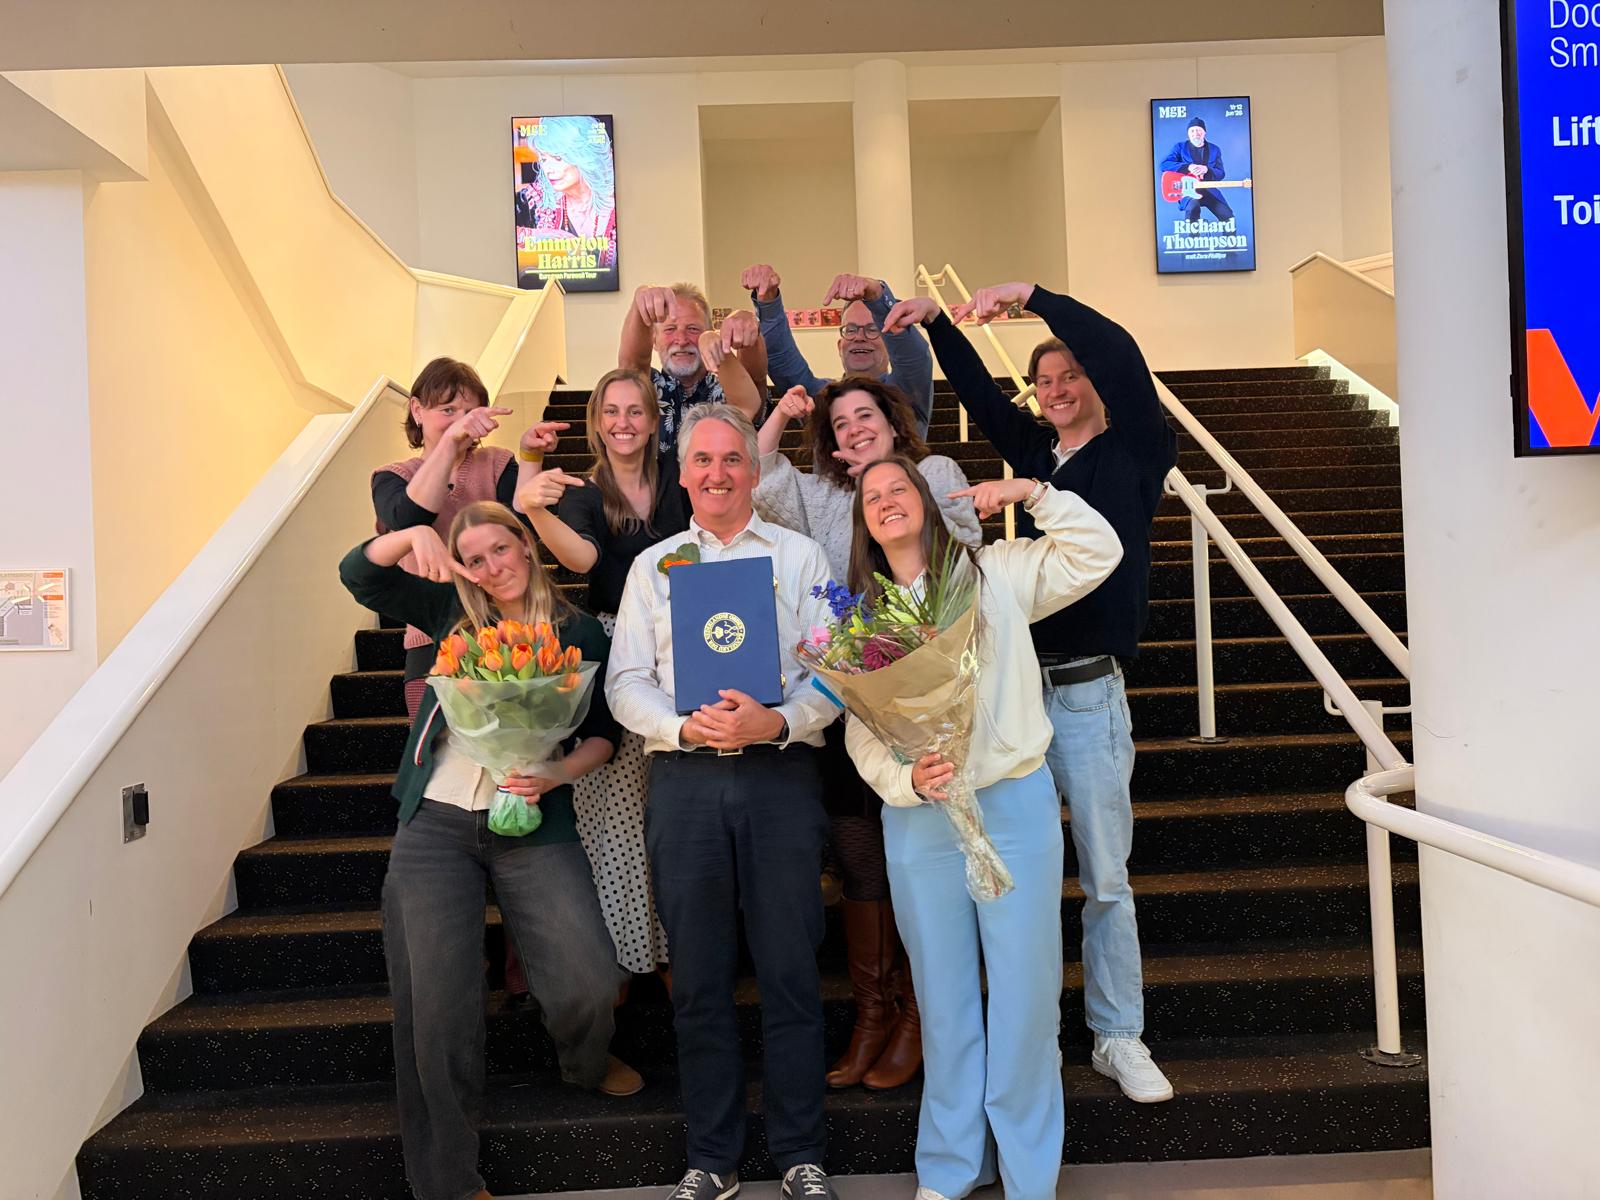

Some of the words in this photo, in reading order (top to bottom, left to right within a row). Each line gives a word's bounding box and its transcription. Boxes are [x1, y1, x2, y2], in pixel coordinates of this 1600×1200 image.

[1550, 36, 1598, 68] Sm
[1553, 194, 1600, 225] Toi
[1174, 217, 1236, 234] Richard
[525, 234, 609, 254] Emmylou
[1163, 234, 1248, 251] Thompson
[537, 251, 597, 269] Harris
